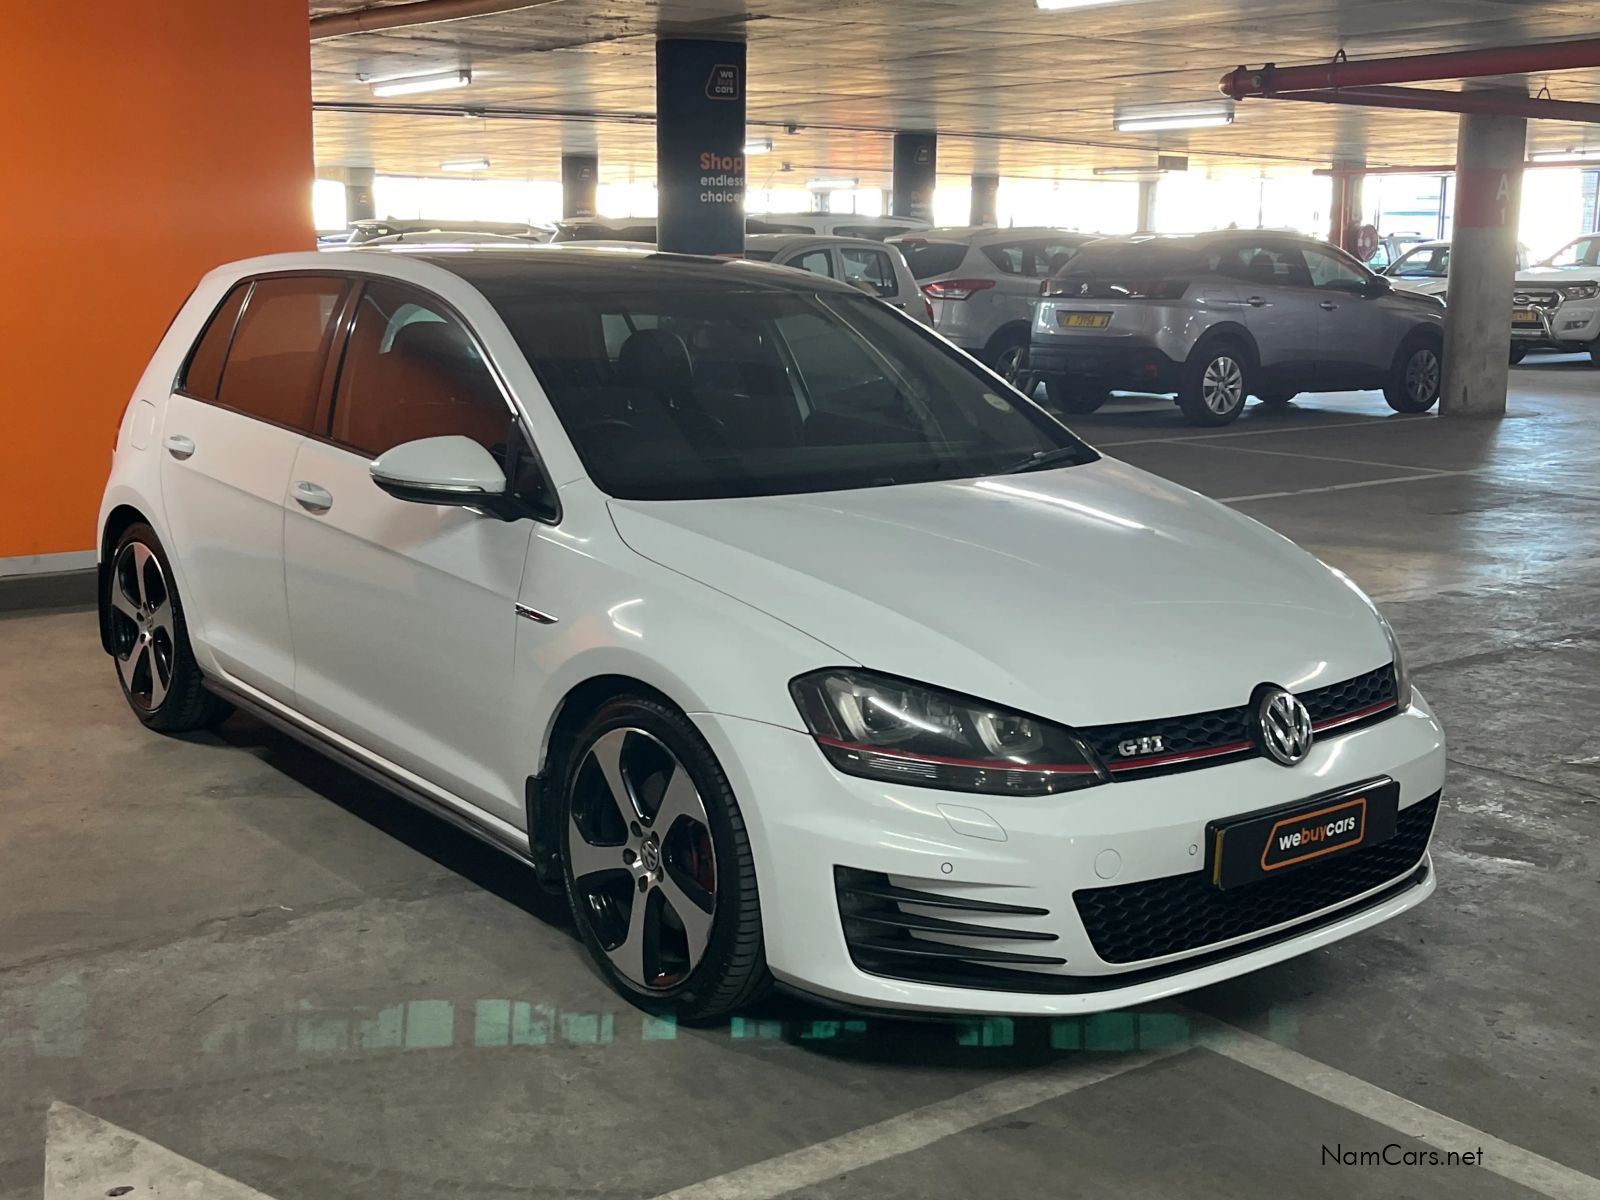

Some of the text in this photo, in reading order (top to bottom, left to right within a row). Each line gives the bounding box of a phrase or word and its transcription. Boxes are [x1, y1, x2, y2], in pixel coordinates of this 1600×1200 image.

[715, 86, 734, 94] cars
[700, 152, 743, 174] Shop
[700, 175, 744, 186] endless
[1118, 735, 1165, 757] GTI
[1279, 816, 1355, 850] webuycars
